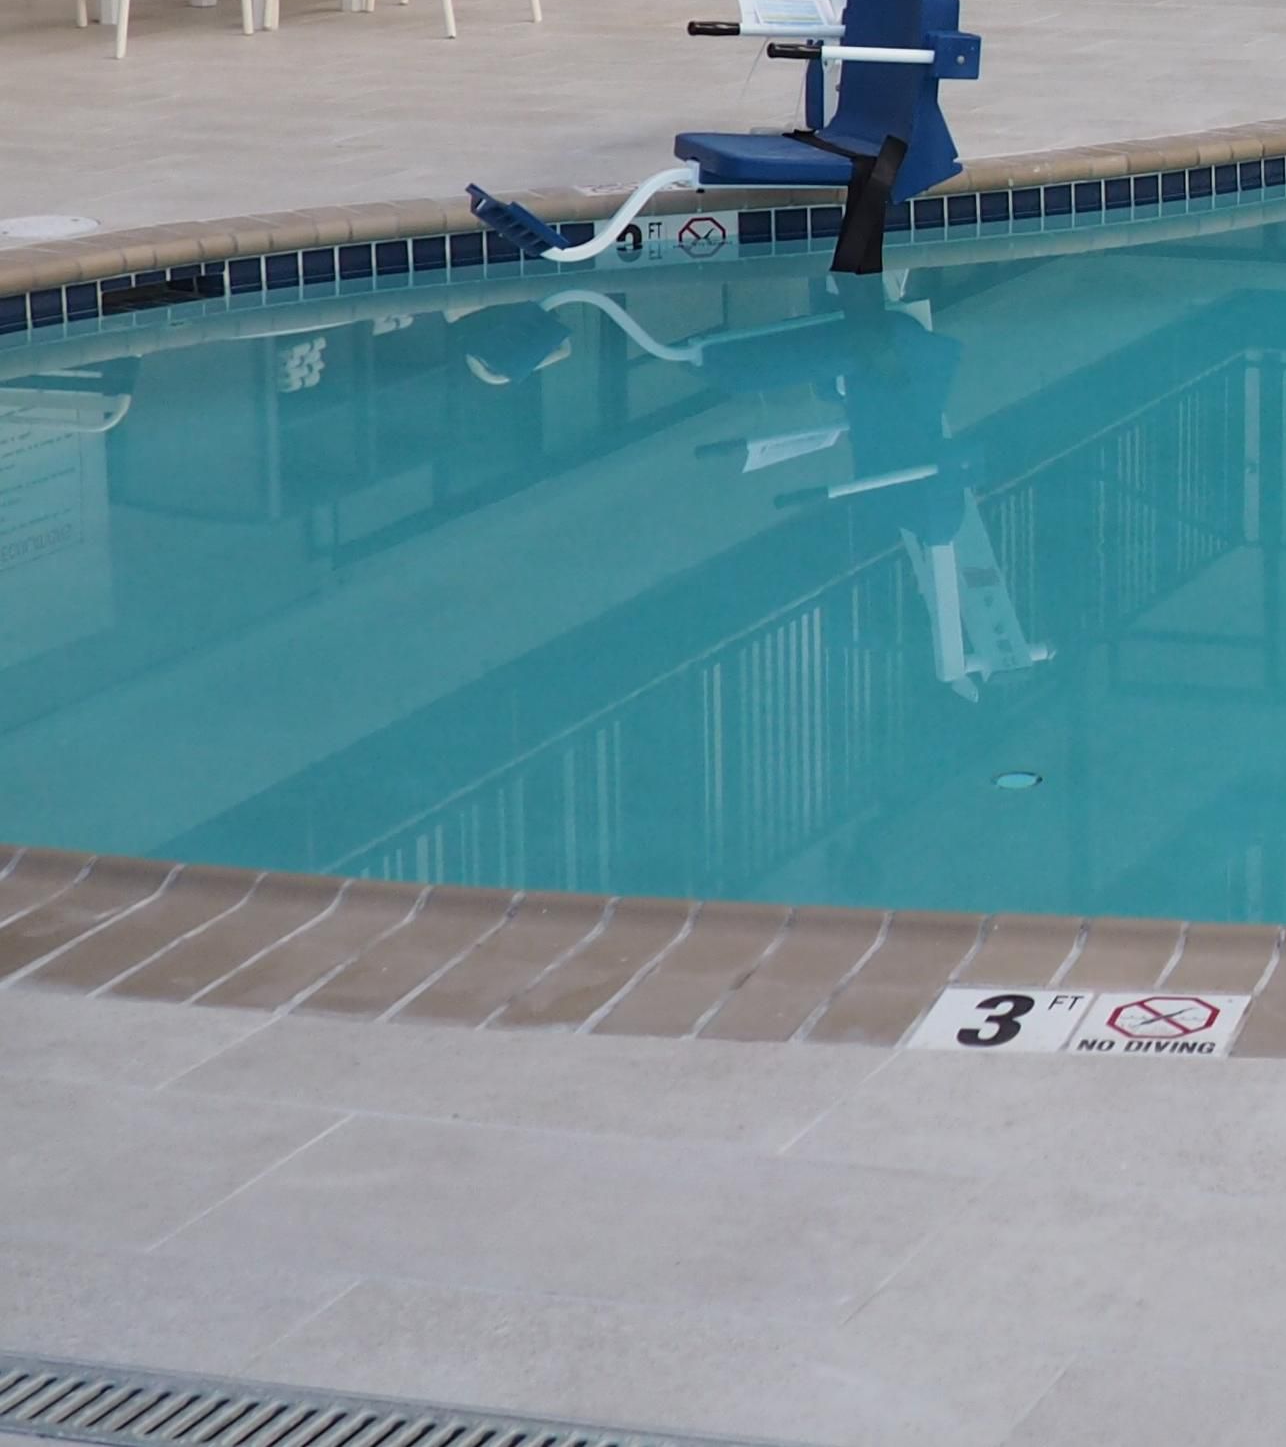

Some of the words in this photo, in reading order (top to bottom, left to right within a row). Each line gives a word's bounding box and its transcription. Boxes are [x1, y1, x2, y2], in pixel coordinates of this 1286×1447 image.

[648, 222, 663, 240] FT
[956, 993, 1036, 1048] 3
[1047, 995, 1085, 1012] FT
[1076, 1038, 1116, 1052] NO
[1123, 1039, 1216, 1054] DIVING
